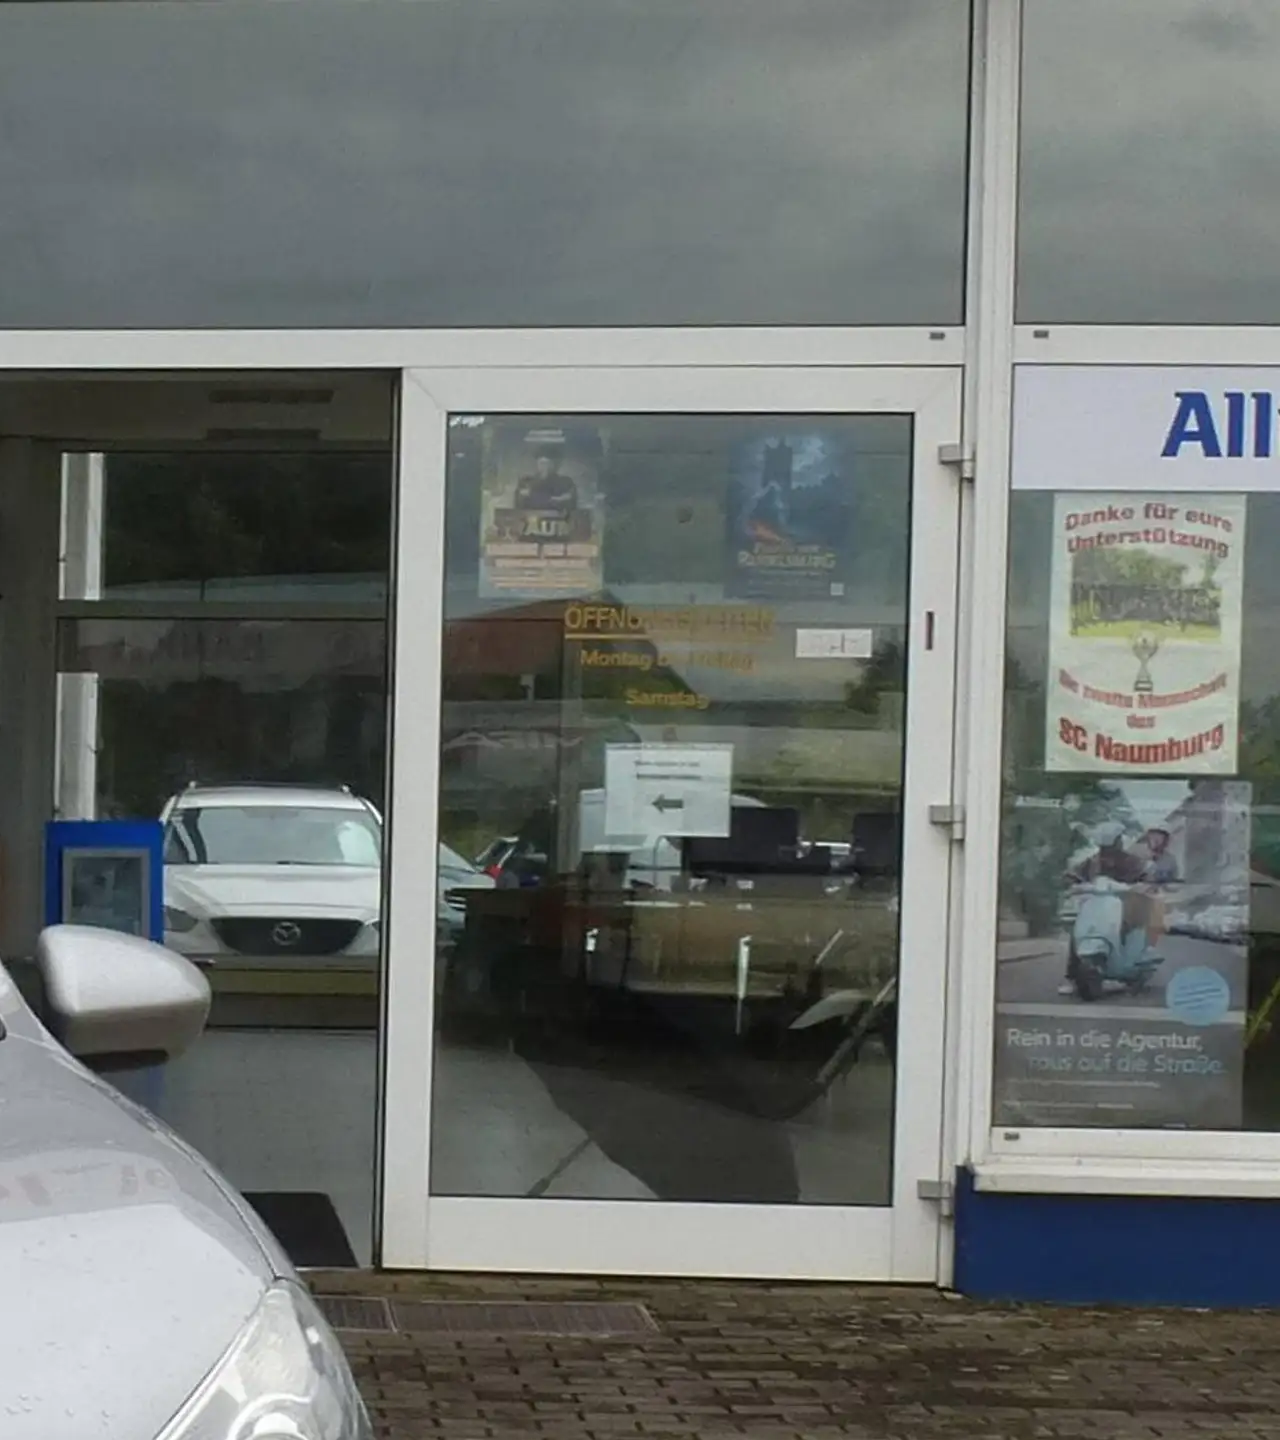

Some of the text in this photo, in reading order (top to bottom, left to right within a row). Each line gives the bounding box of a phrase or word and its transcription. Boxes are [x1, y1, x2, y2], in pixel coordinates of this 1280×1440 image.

[1160, 391, 1280, 458] All
[1066, 502, 1232, 532] Danke für eure
[1067, 527, 1229, 558] Unterstützung
[580, 650, 653, 670] Montag
[624, 688, 710, 710] Samstag
[1059, 717, 1224, 763] SC Naumburg
[1007, 1028, 1203, 1052] Rein in die Agentur,
[1117, 1054, 1147, 1073] die
